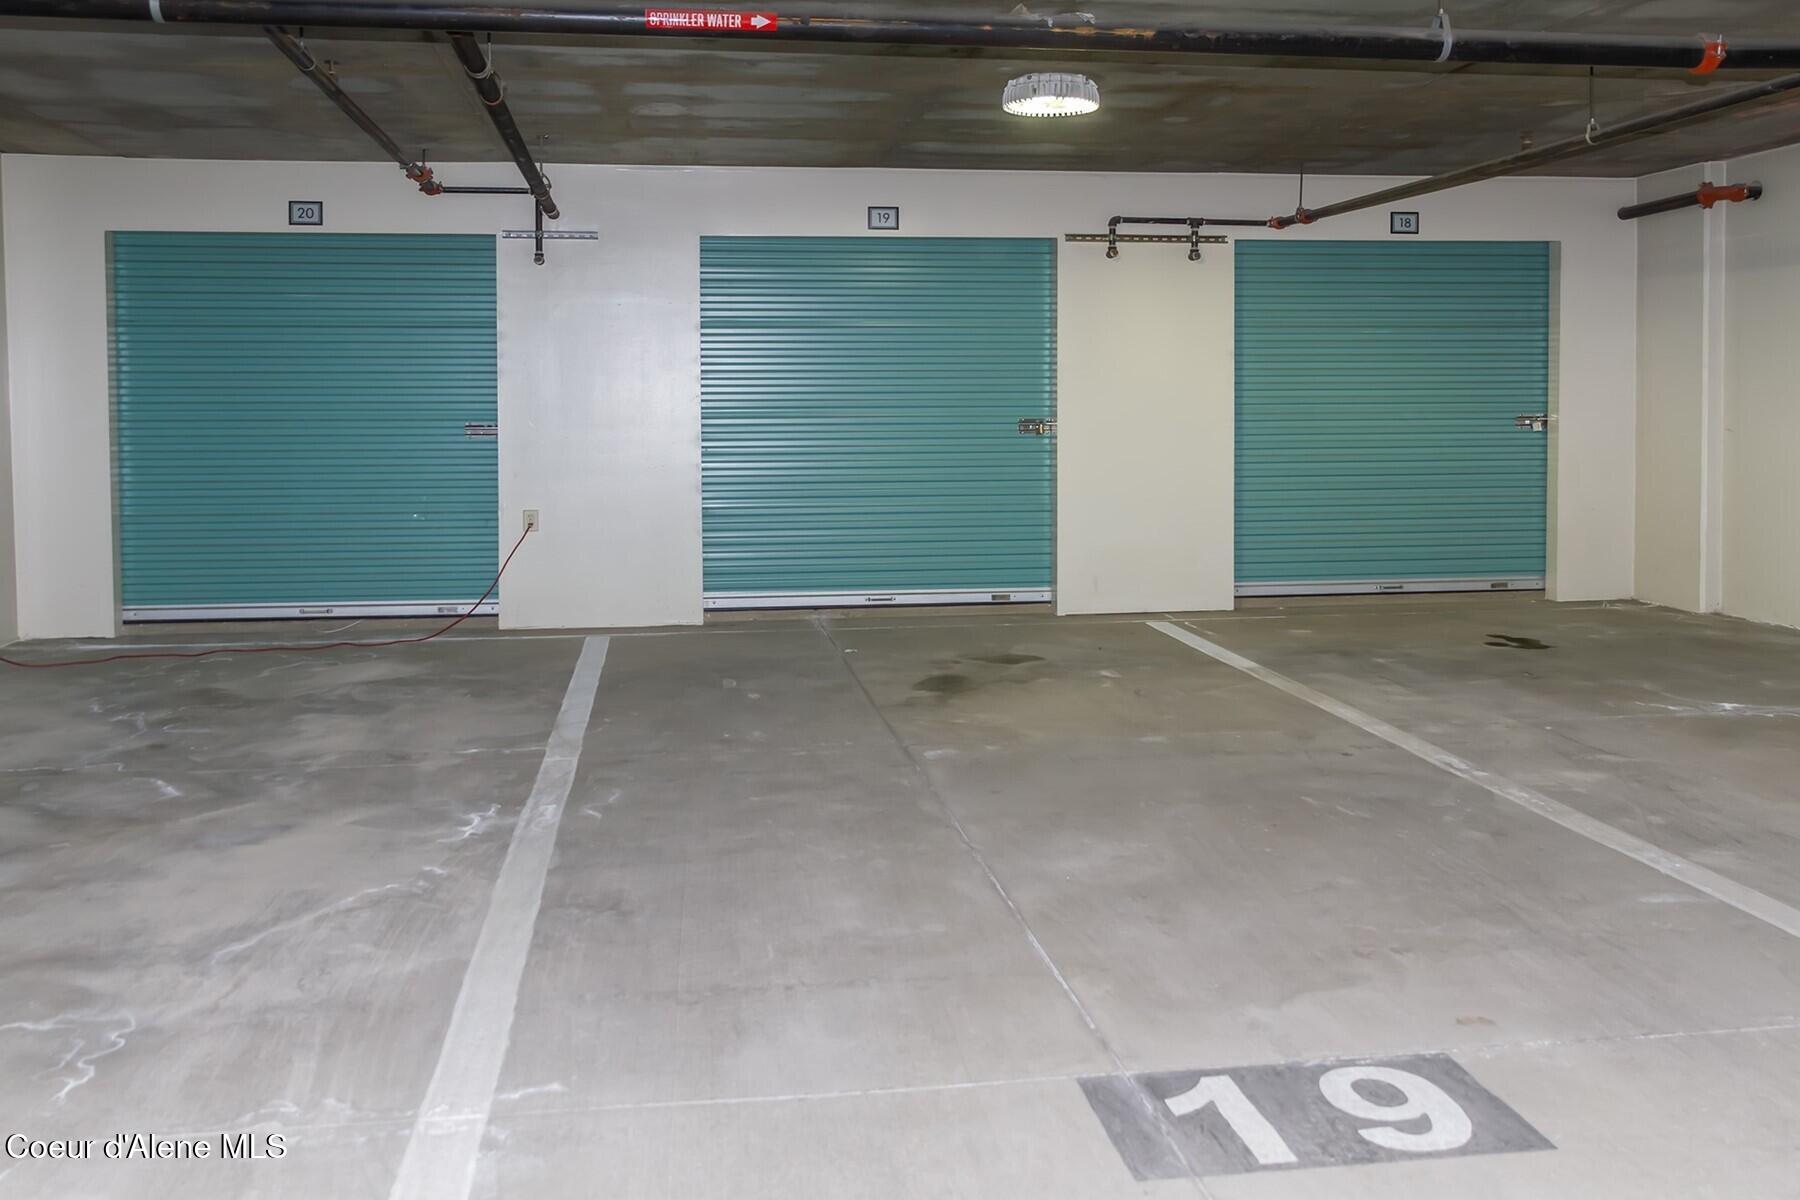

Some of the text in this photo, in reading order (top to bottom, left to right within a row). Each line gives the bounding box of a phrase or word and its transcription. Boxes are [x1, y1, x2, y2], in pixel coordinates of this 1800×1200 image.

[649, 11, 742, 28] SPRINKLER WATER
[297, 207, 314, 219] 20
[877, 212, 890, 224] 19
[1400, 217, 1411, 228] 18
[1165, 1066, 1473, 1165] 19
